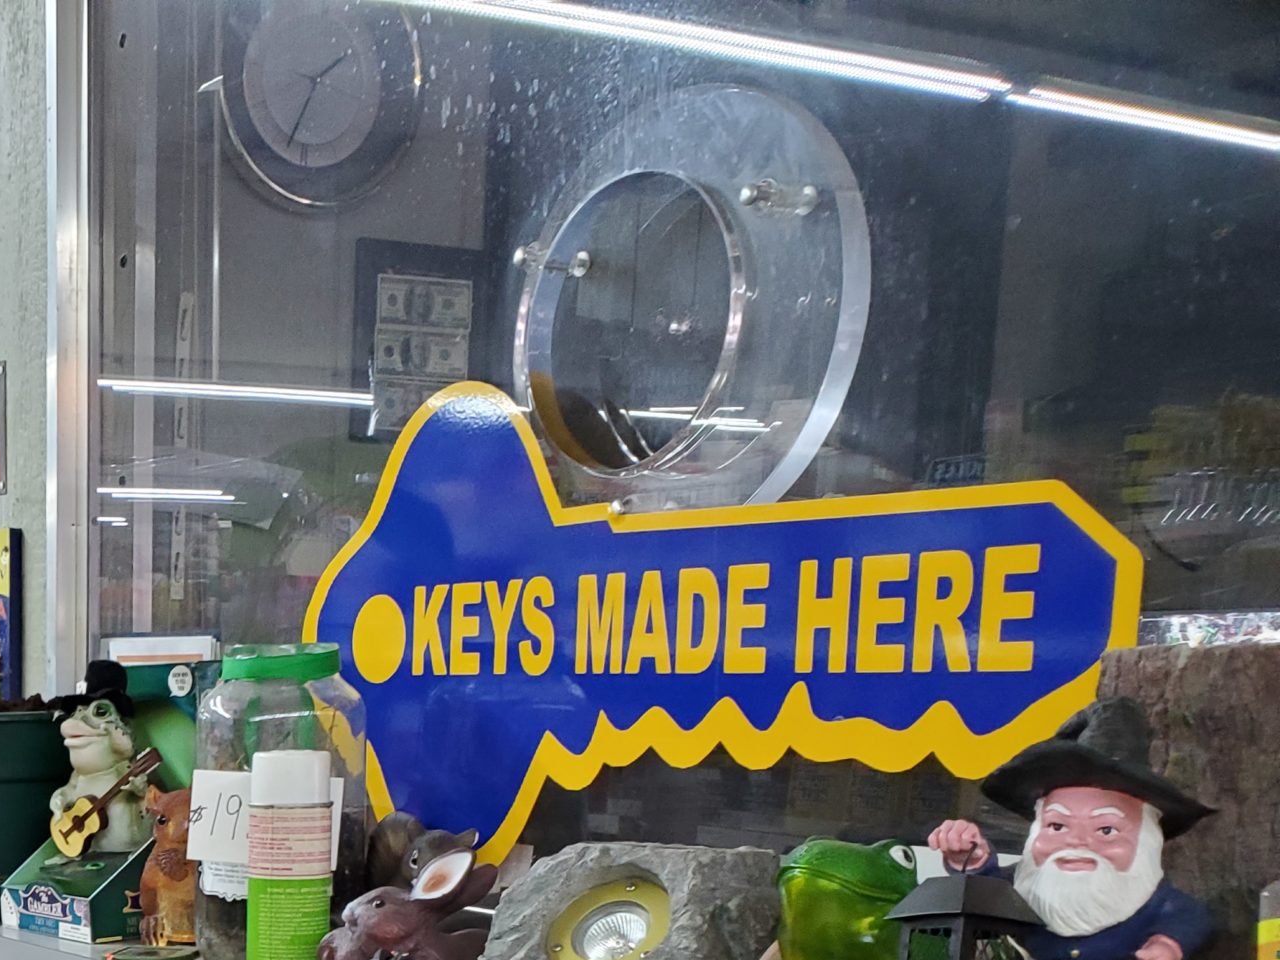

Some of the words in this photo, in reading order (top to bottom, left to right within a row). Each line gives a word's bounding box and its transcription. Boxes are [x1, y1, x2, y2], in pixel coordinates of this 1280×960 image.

[411, 575, 555, 677] KEYS
[574, 562, 771, 675] MADE
[794, 543, 1042, 674] HERE
